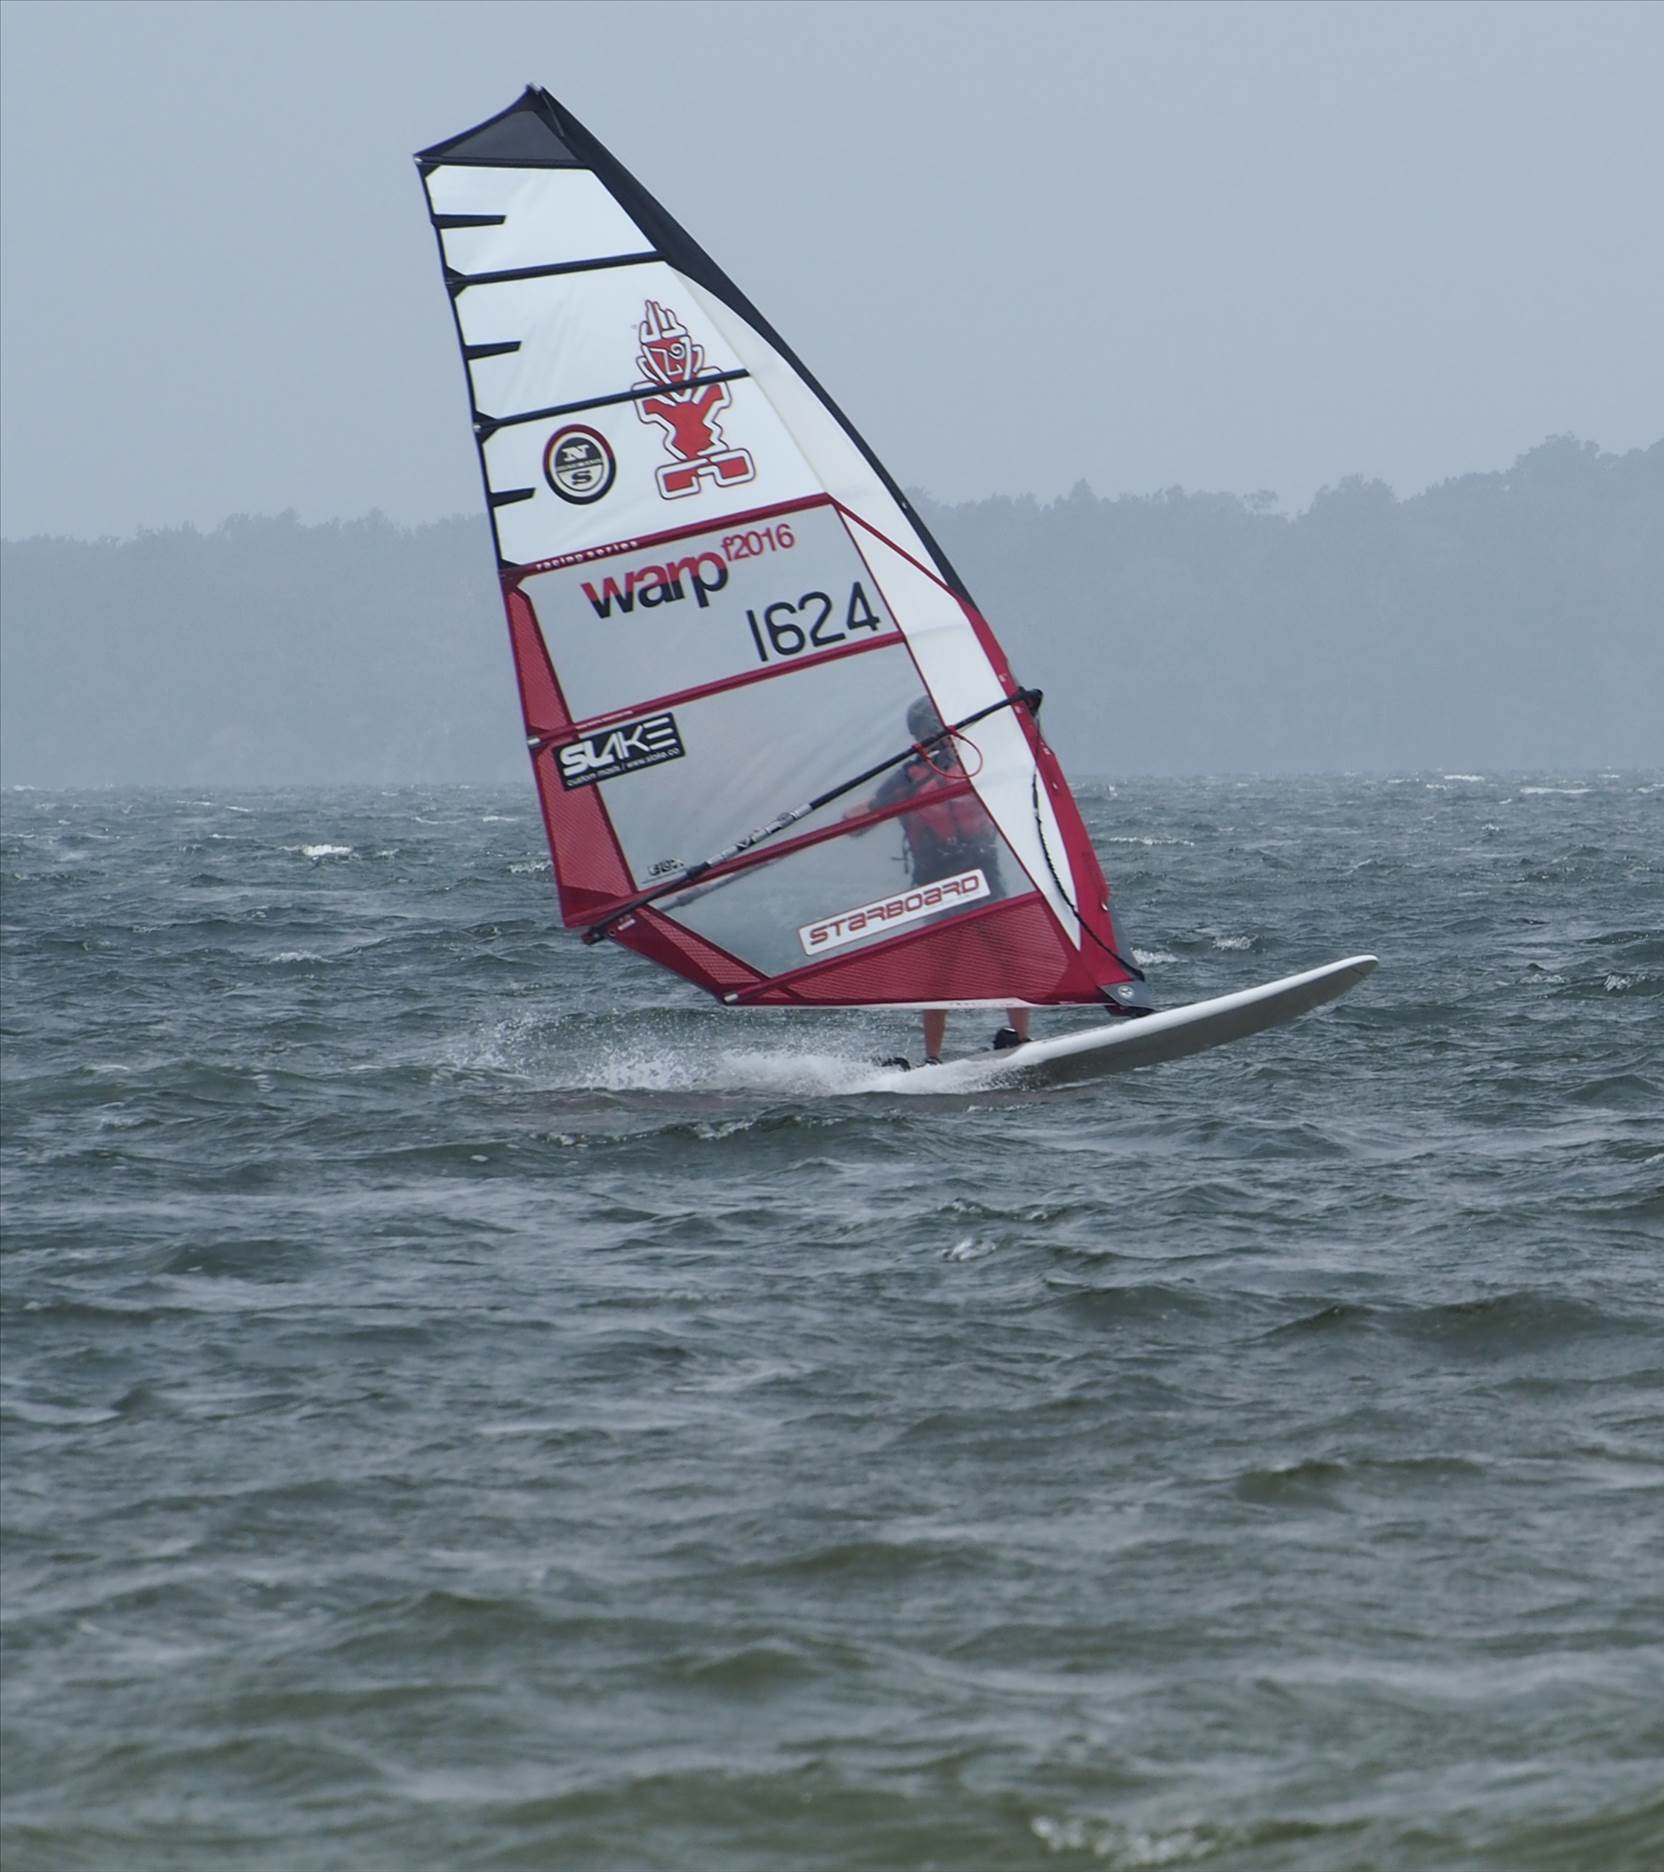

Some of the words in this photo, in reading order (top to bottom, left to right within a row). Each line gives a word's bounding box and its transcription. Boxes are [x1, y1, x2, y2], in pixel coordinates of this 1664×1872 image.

[561, 444, 590, 462] N
[571, 470, 592, 485] S
[580, 551, 728, 619] warp
[720, 523, 796, 562] f2016
[746, 581, 881, 662] 1624
[560, 717, 677, 777] SLAKE
